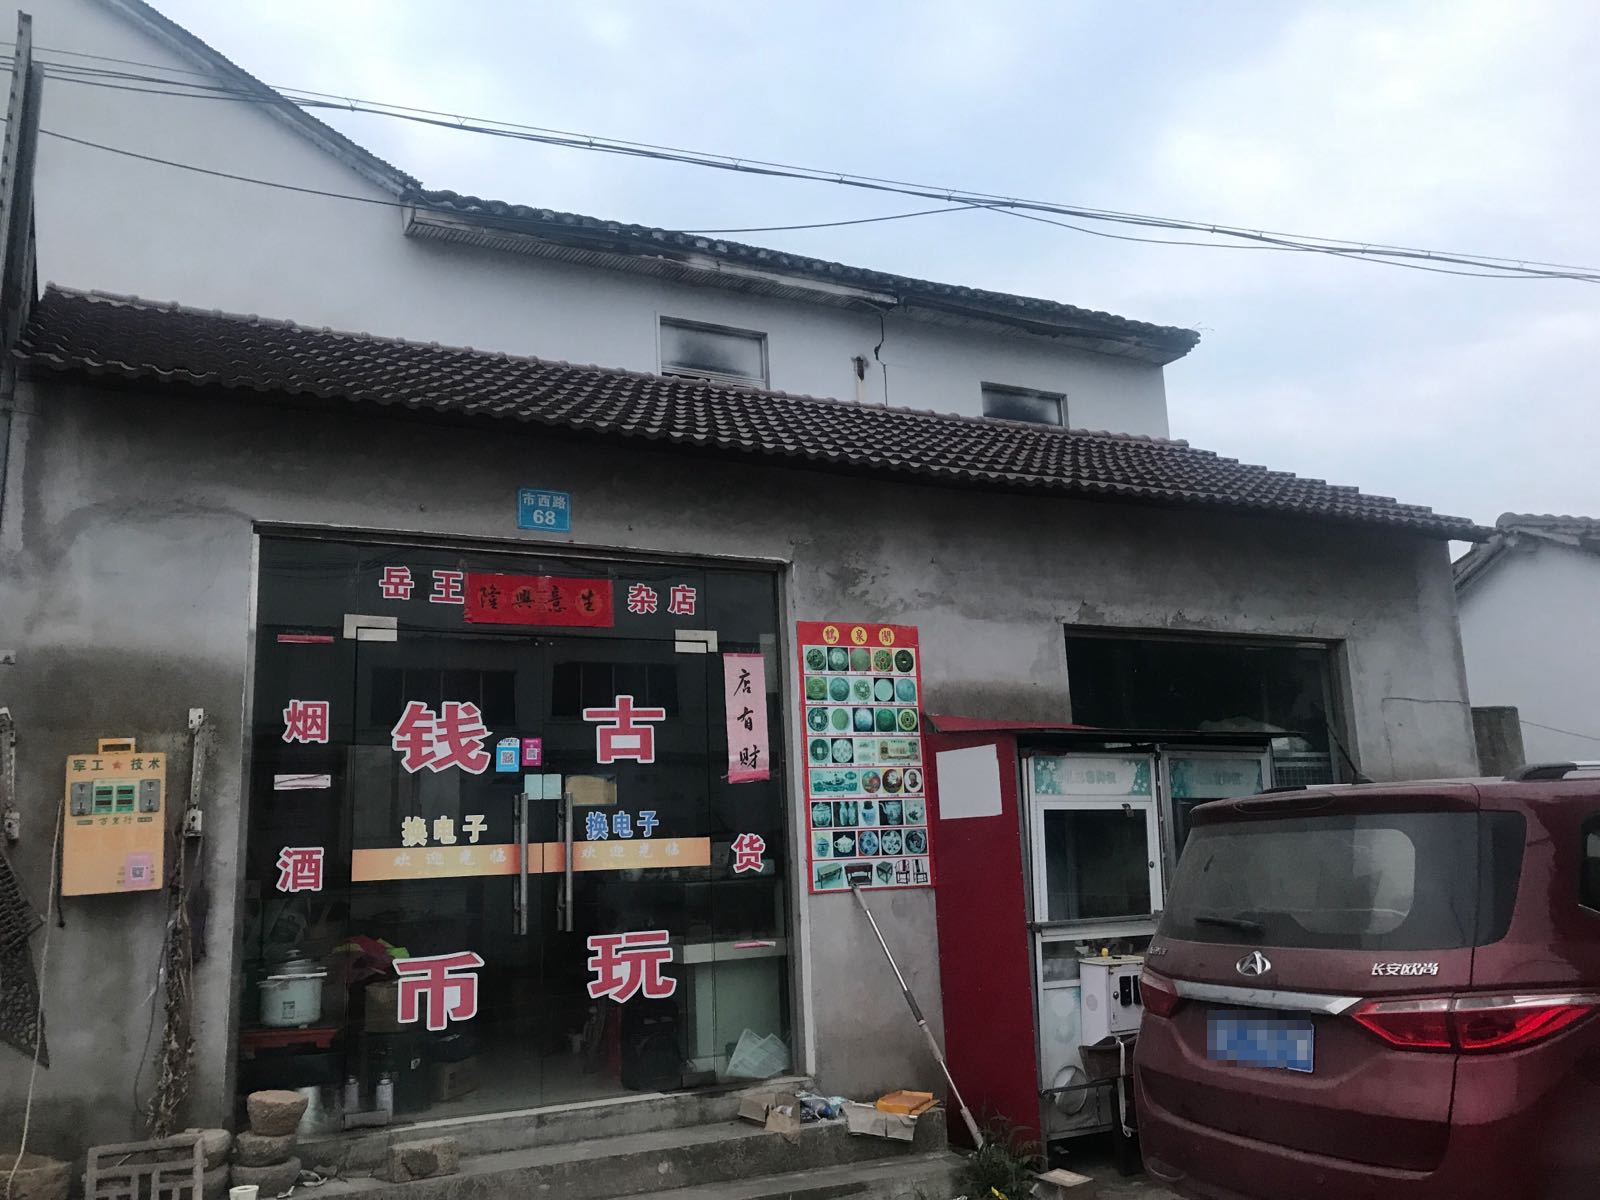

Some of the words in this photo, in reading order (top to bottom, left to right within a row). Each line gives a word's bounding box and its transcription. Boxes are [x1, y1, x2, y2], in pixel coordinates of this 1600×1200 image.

[522, 492, 566, 510] 市西路
[533, 509, 556, 525] 68
[402, 814, 488, 847] 换电子
[586, 810, 660, 841] 换电子
[1371, 962, 1439, 976] 长安欧尚
